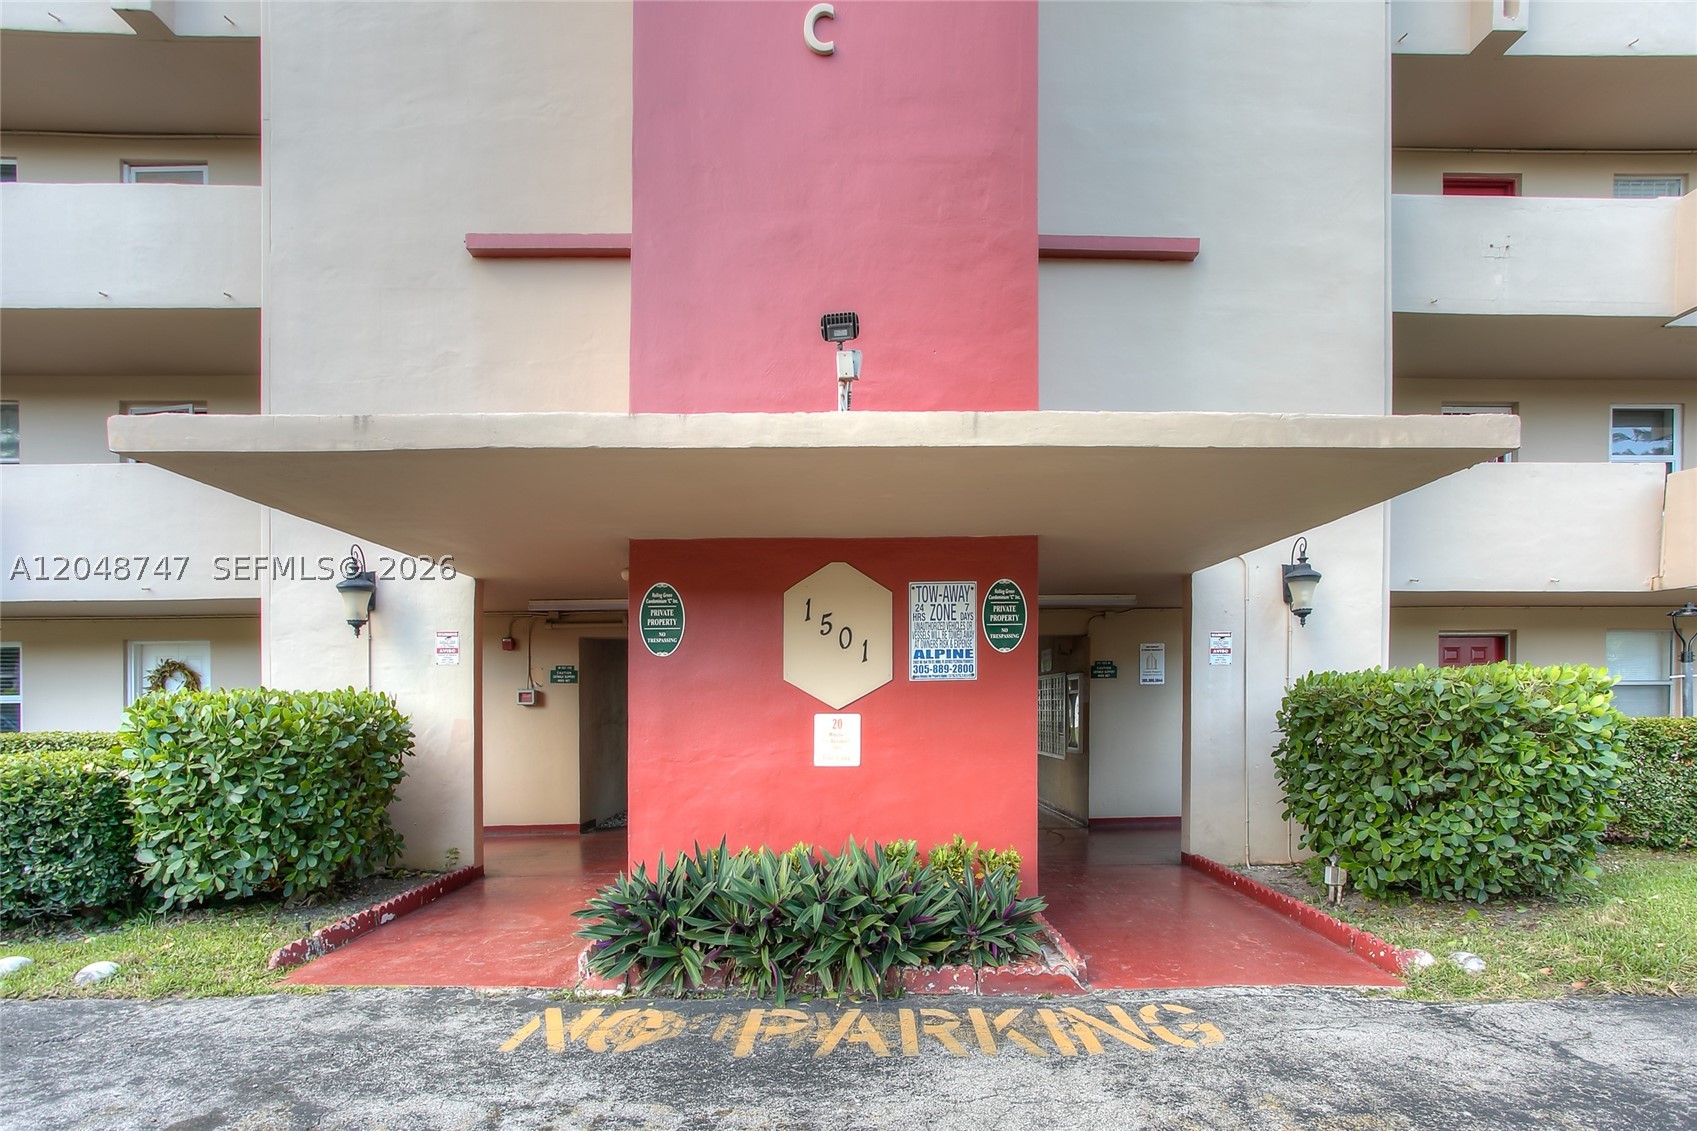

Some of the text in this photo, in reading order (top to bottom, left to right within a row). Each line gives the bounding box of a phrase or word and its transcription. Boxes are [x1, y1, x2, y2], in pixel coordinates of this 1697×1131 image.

[803, 3, 834, 56] C
[916, 585, 970, 603] TOW-AWAY
[915, 603, 924, 612] 24
[930, 603, 957, 621] ZONE
[965, 603, 970, 612] 7
[992, 605, 1017, 613] PRIVATE
[650, 609, 675, 617] PRIVATE
[913, 613, 926, 621] HRS
[960, 612, 974, 621] DAYS
[647, 618, 678, 626] PROPERTY
[989, 614, 1020, 622] PROPERTY
[914, 621, 945, 631] UNAUTHORIZED
[946, 621, 966, 630] VEHICLES
[912, 630, 974, 639] VESSELS WILL BE TOWED AWAY
[920, 639, 938, 648] OWNERS
[954, 639, 973, 648] EXPENSE
[913, 648, 974, 659] ALPINE
[913, 664, 974, 674] 305-889-2800
[832, 718, 843, 730] 20
[498, 1003, 1225, 1058] NO PARKING
